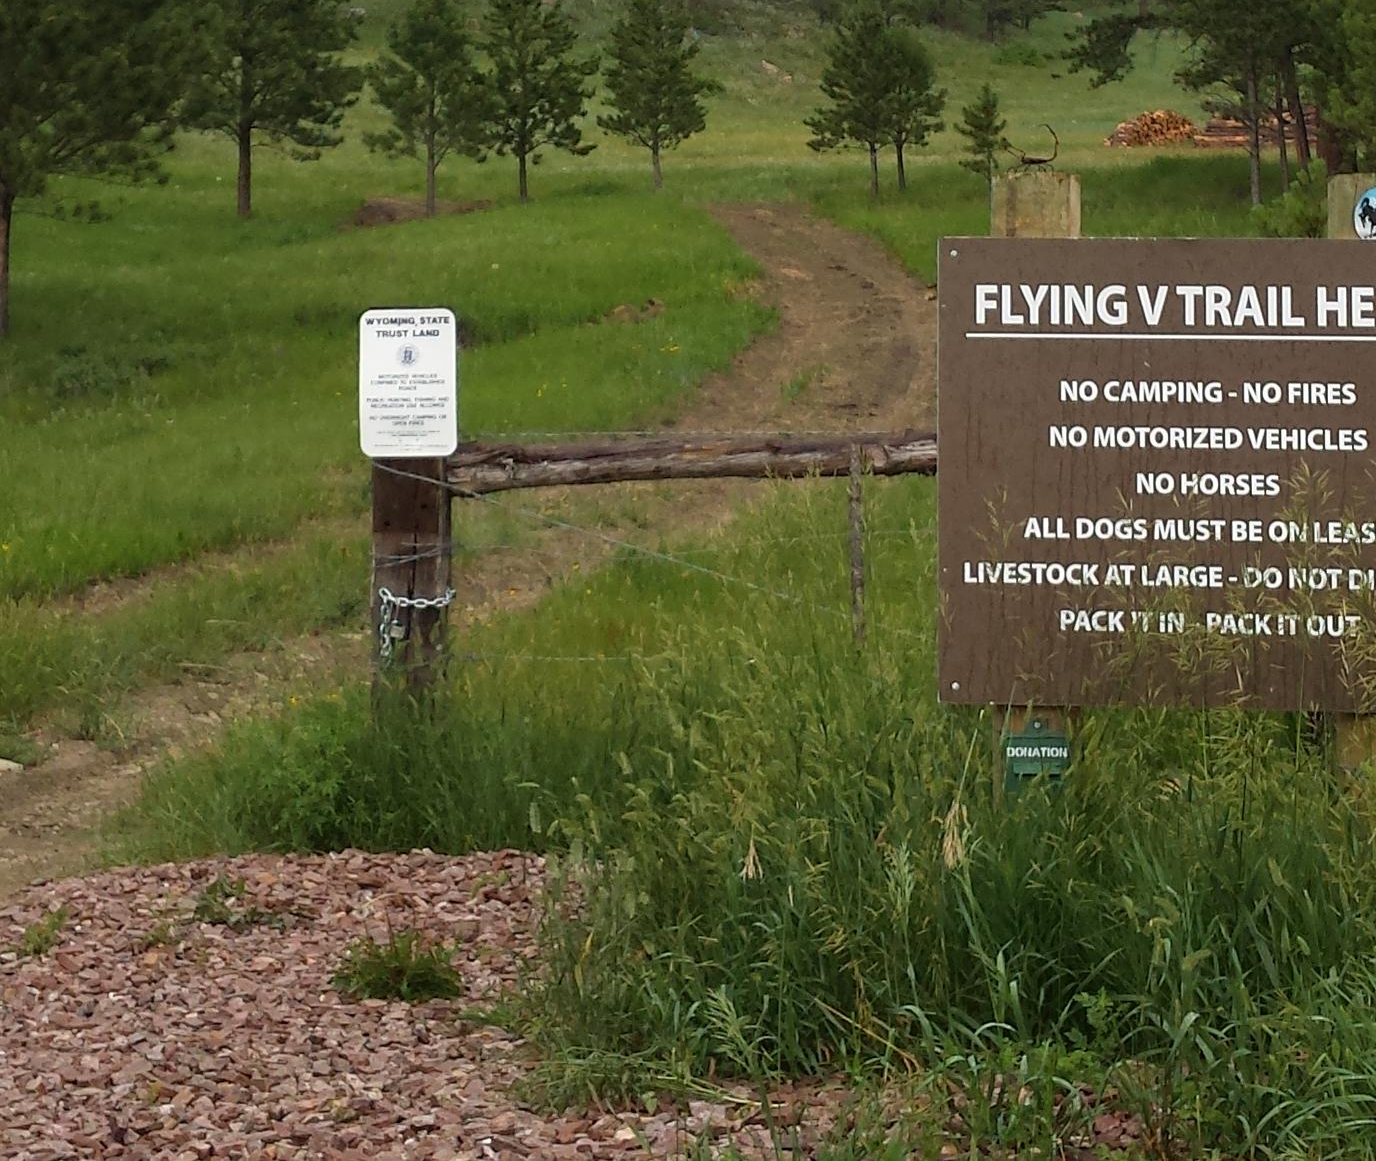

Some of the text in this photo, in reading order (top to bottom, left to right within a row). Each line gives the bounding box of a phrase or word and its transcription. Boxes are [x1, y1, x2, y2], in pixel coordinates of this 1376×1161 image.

[975, 284, 1128, 326] FLYING
[1137, 285, 1169, 326] V
[1176, 285, 1305, 327] TRAIL
[365, 316, 450, 326] WYOMING STATE
[376, 329, 440, 338] TRUST LAND
[1060, 381, 1098, 402] NO
[1104, 381, 1223, 403] CAMPING
[1243, 382, 1282, 404] NO
[1288, 383, 1357, 405] FIRES
[1049, 426, 1368, 451] NO MOTORIZED VEHICLES
[1136, 473, 1281, 496] NO HORSES
[1024, 517, 1070, 539] ALL
[1076, 518, 1148, 540] DOGS
[1154, 520, 1227, 541] MUST
[1232, 520, 1263, 542] BE
[1269, 521, 1308, 543] ON
[964, 562, 1099, 585] LIVESTOCK
[1105, 564, 1136, 586] AT
[1141, 565, 1224, 587] LARGE
[1243, 566, 1283, 589] DO
[1288, 567, 1343, 589] NOT
[1060, 610, 1125, 632] PACK
[1159, 612, 1185, 633] IN
[1206, 613, 1272, 635] PACK
[1277, 614, 1301, 636] IT
[1306, 615, 1362, 637] OUT
[1006, 746, 1068, 759] DONATION
